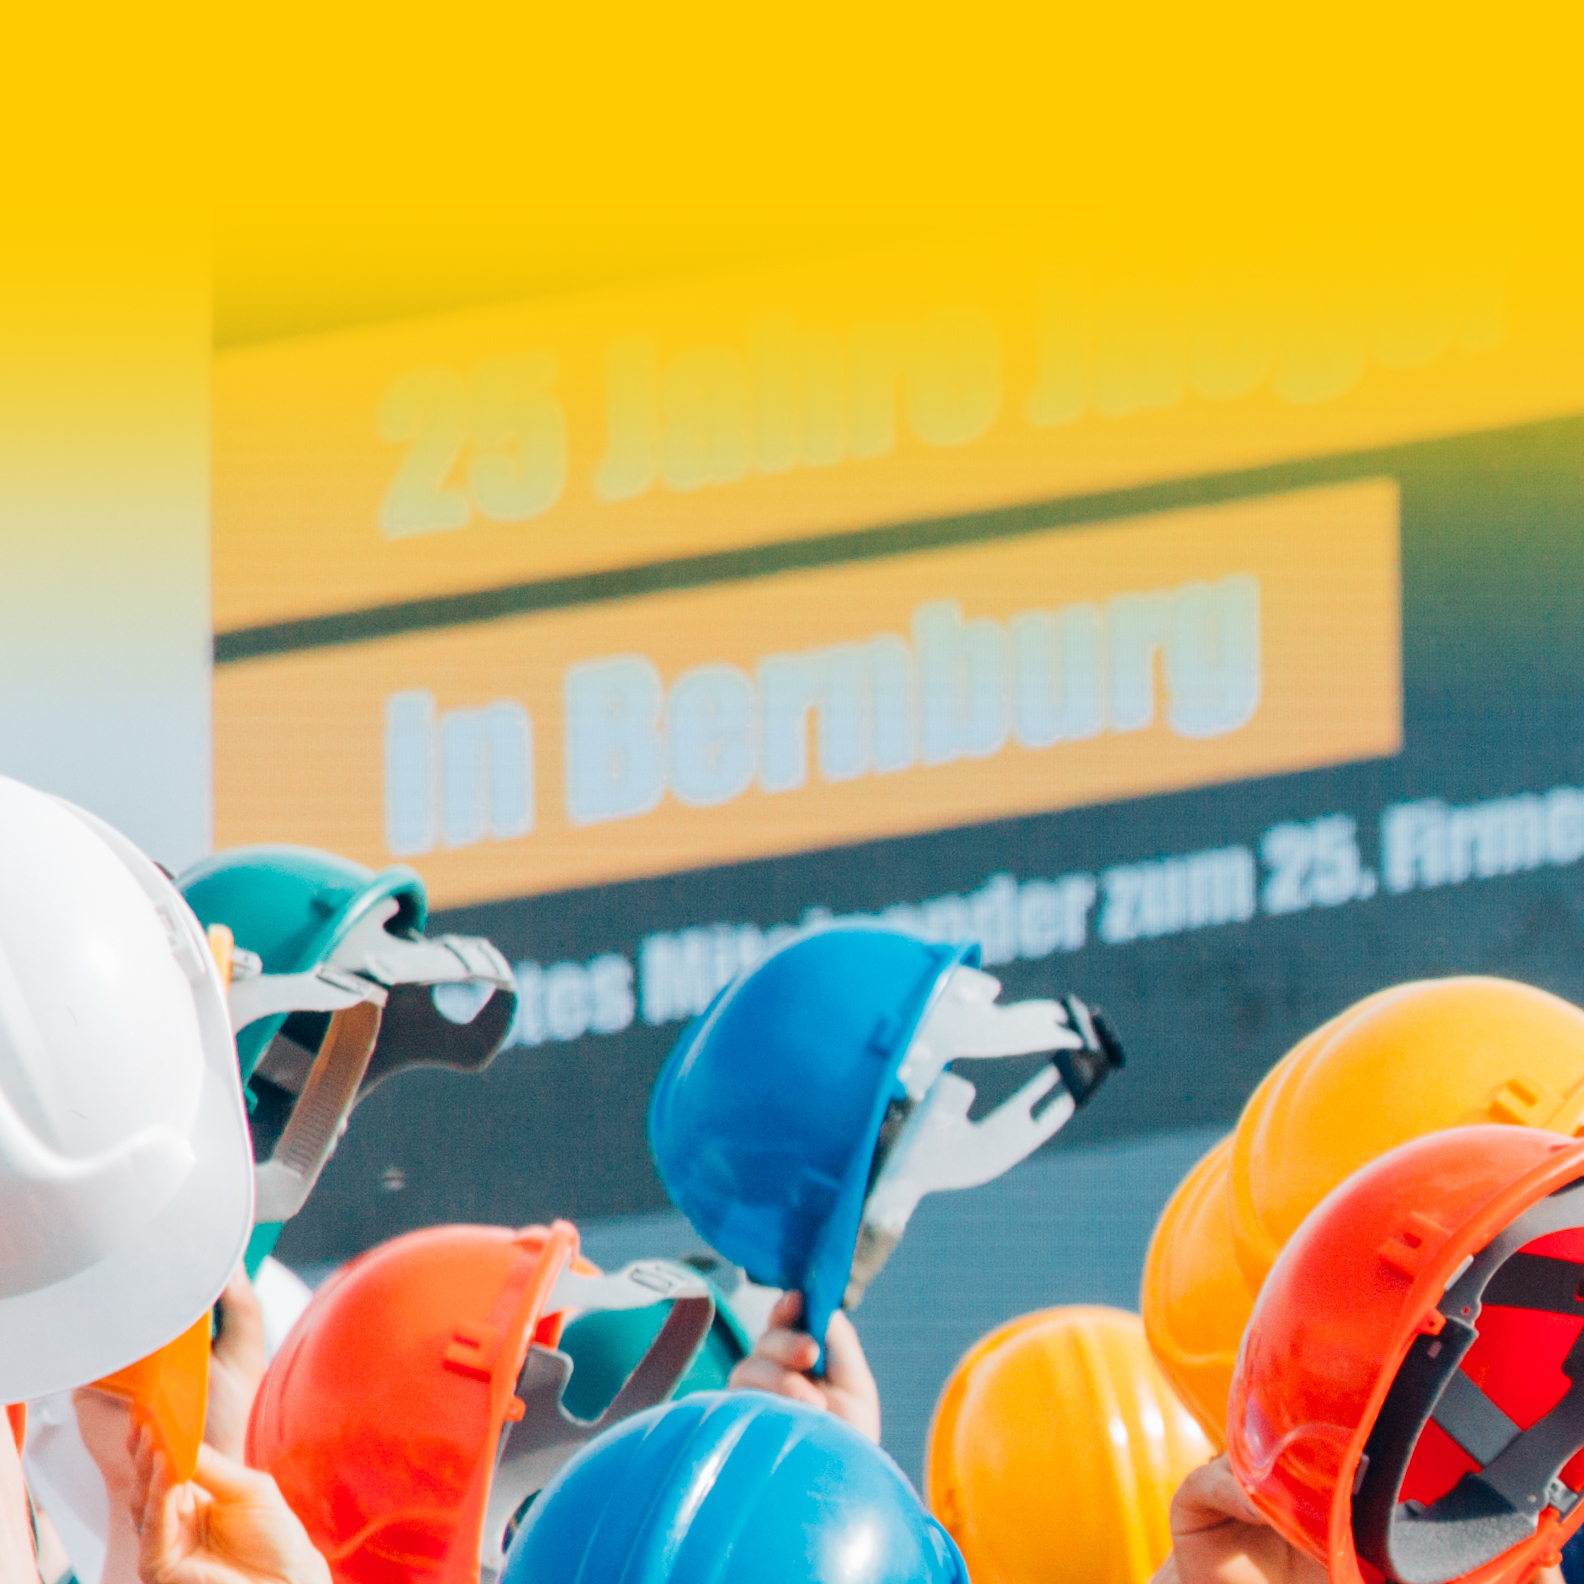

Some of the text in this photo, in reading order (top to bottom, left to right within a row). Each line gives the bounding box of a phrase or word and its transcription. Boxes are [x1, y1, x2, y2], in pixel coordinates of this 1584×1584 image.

[376, 347, 568, 541] 25
[592, 302, 1003, 503] Jahre
[564, 572, 1264, 826] Bernburg
[1097, 844, 1257, 946] zum
[1260, 812, 1377, 917] 25.
